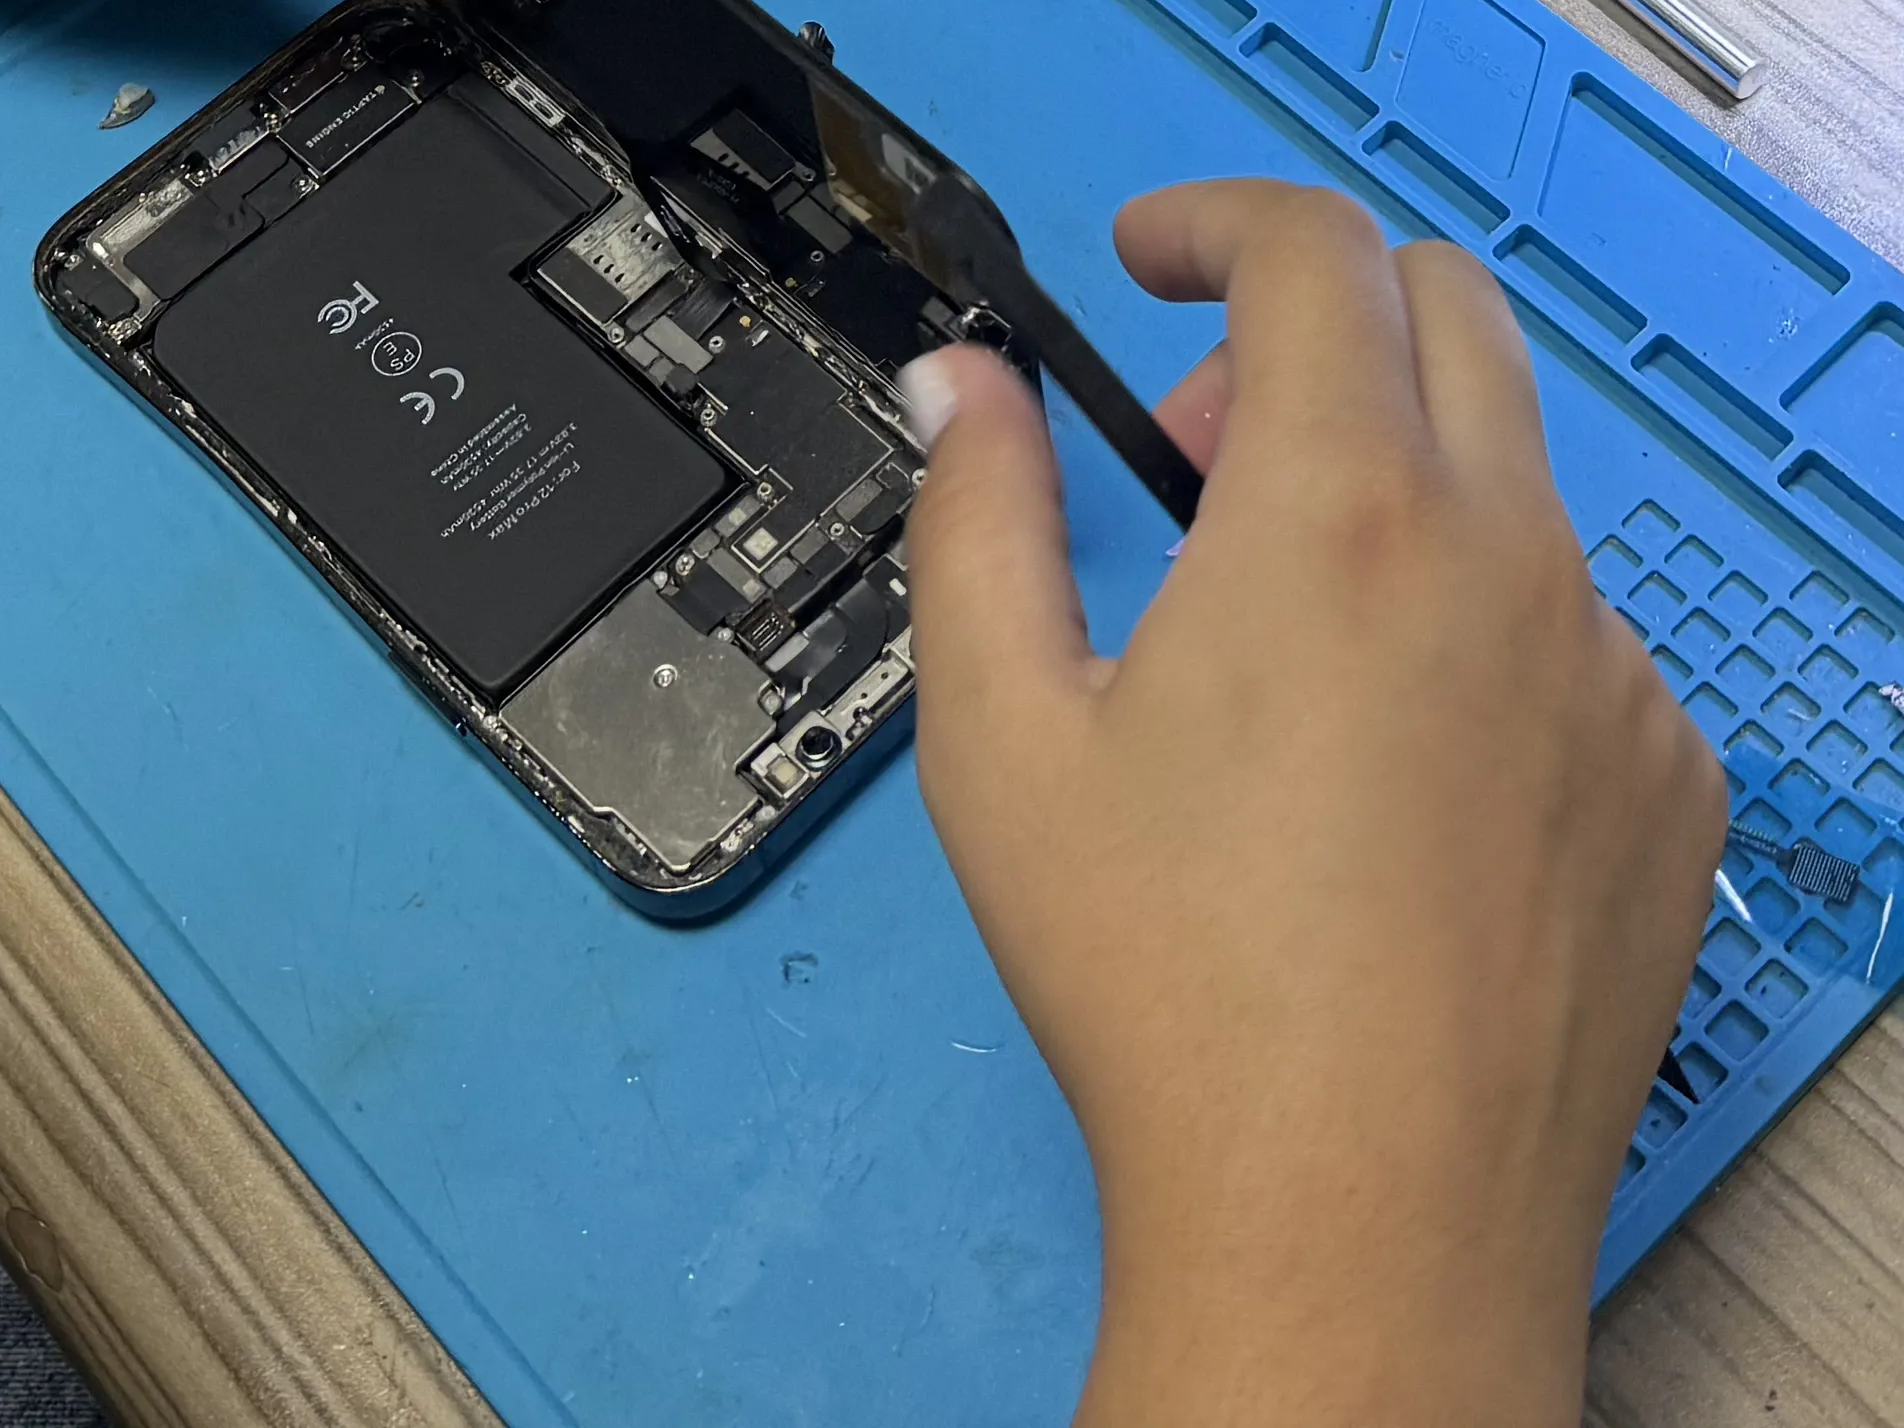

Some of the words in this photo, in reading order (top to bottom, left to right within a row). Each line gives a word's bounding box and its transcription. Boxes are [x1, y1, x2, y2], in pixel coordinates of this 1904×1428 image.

[400, 367, 465, 425] CE
[466, 403, 519, 448] Assembled
[429, 451, 460, 479] China
[536, 481, 556, 500] 12
[467, 497, 508, 532] Battery
[513, 494, 541, 519] Pro
[486, 513, 519, 542] Max
